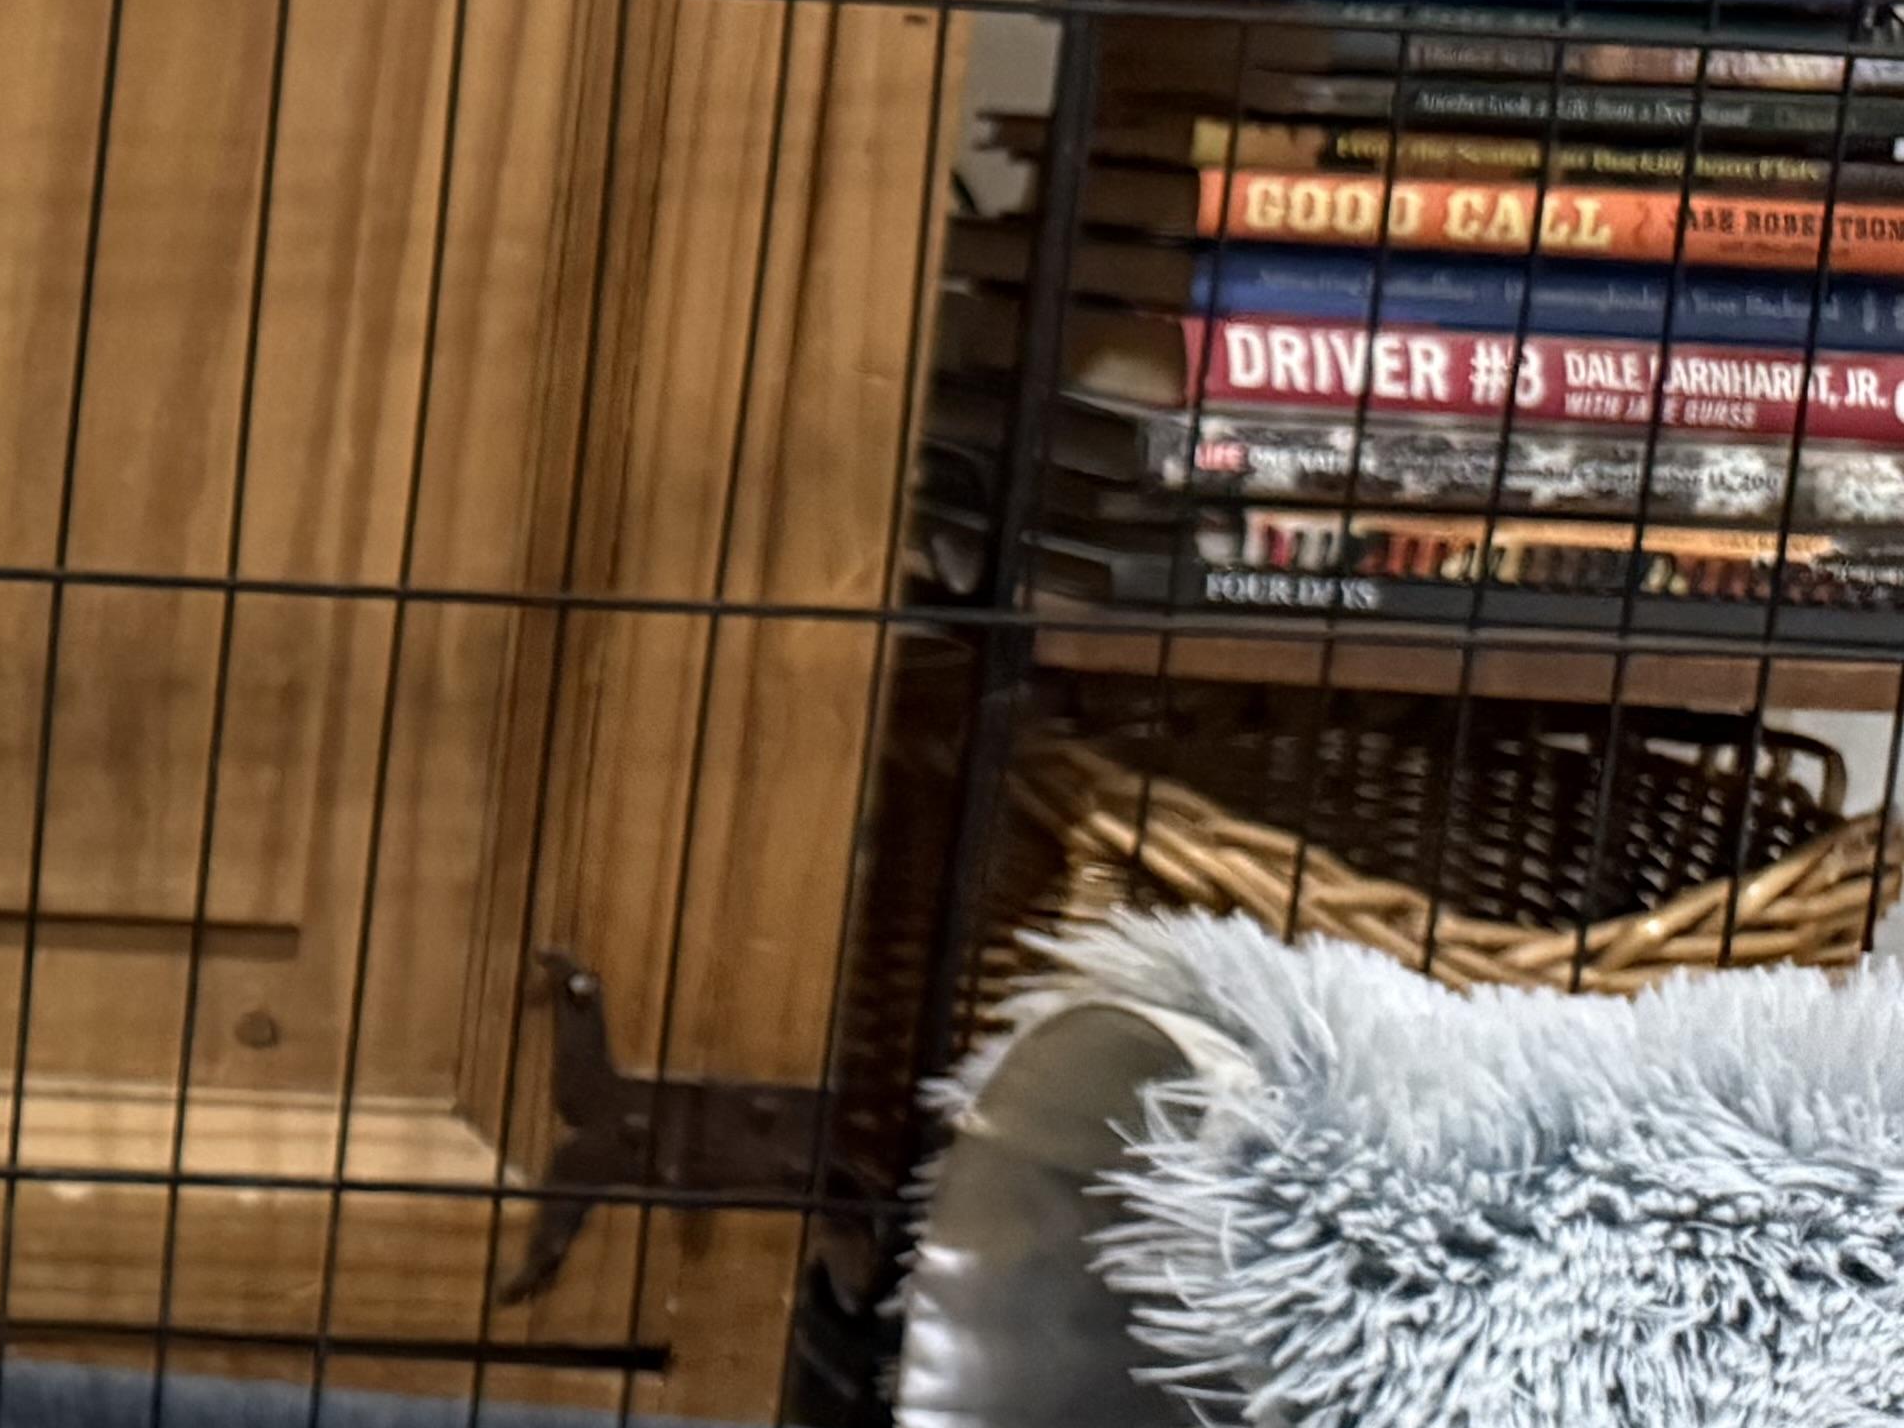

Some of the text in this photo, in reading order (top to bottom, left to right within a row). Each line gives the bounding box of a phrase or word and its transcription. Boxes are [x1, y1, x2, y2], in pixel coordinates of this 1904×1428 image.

[1245, 180, 1423, 239] GOOD
[1444, 189, 1612, 250] CALL
[1741, 208, 1904, 244] ROBETSON
[1224, 323, 1449, 402] DRIVER
[1468, 337, 1545, 408] #8
[1563, 349, 1640, 394] DALE
[1844, 367, 1890, 410] JR.
[1624, 395, 1680, 423] JAE
[1205, 572, 1293, 604] FOUR
